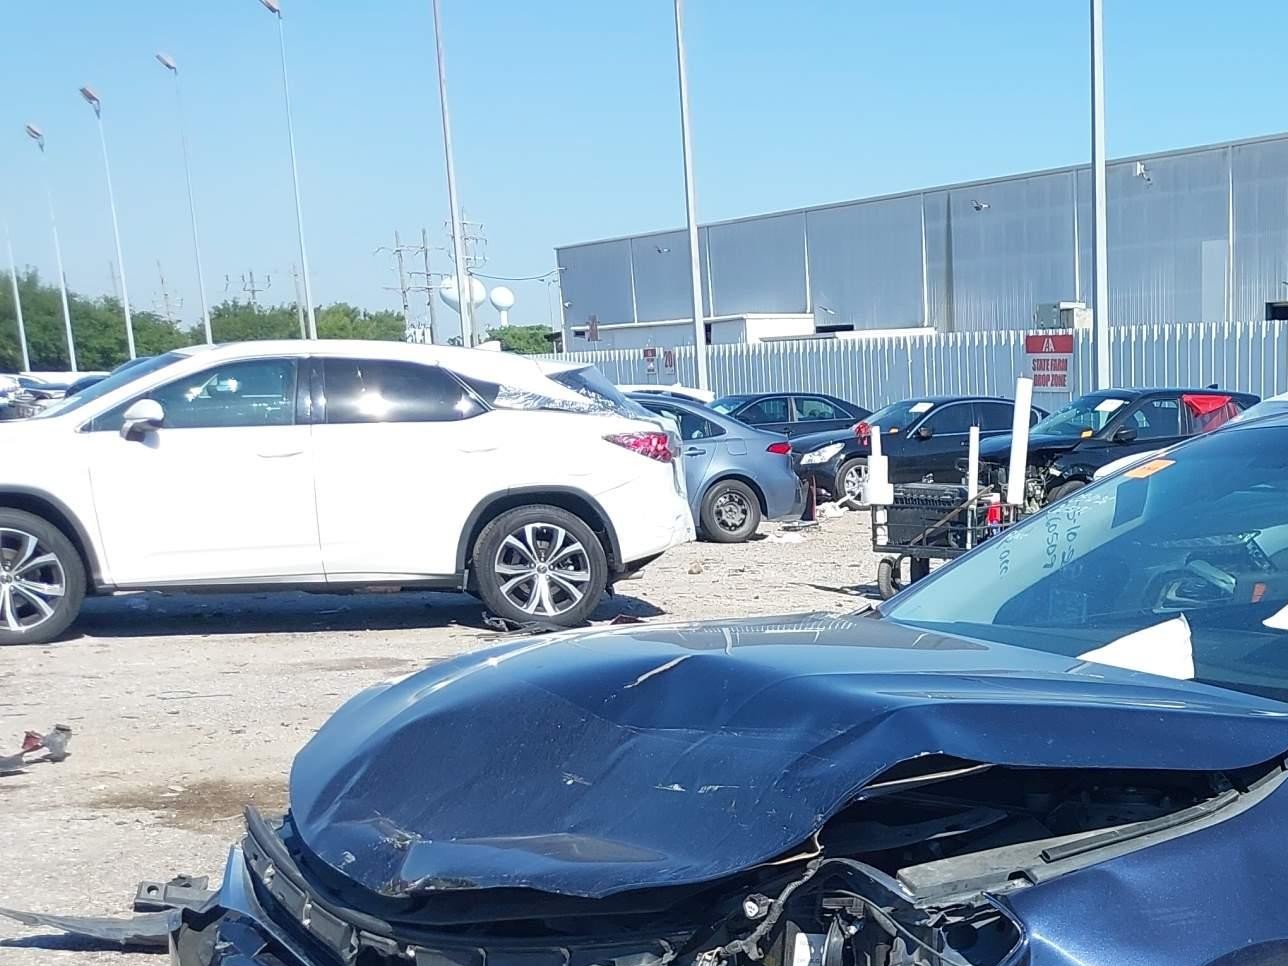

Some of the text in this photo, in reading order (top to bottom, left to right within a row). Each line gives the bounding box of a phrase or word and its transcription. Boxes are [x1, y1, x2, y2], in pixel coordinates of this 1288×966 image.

[1032, 358, 1068, 371] STATE FARM
[1033, 374, 1067, 387] DROP ZONE
